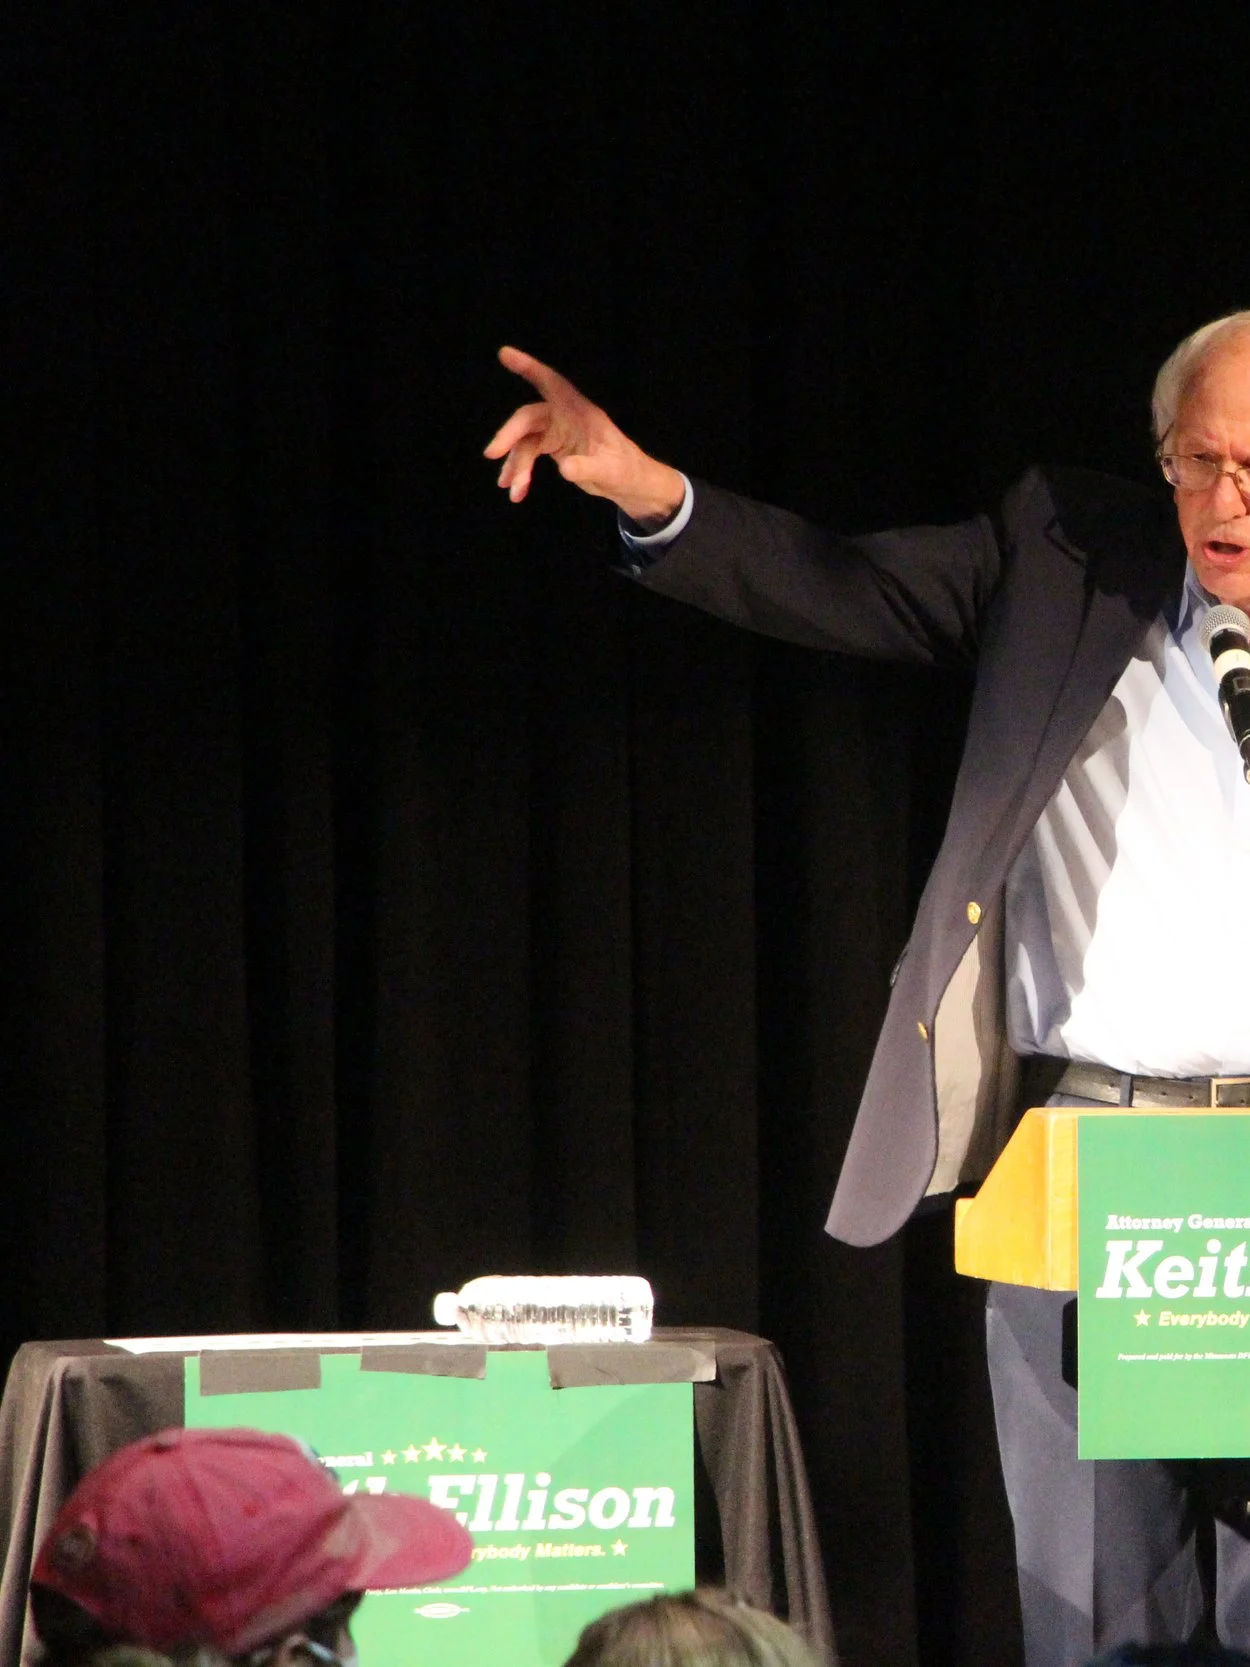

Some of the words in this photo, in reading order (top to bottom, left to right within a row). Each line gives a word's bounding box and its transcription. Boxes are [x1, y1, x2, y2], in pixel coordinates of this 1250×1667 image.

[1105, 1214, 1184, 1233] Attorney
[1158, 1310, 1250, 1328] Everybody
[318, 1451, 374, 1467] neral
[428, 1472, 676, 1532] Ellison
[469, 1542, 532, 1562] rybody
[534, 1542, 607, 1558] Matters.
